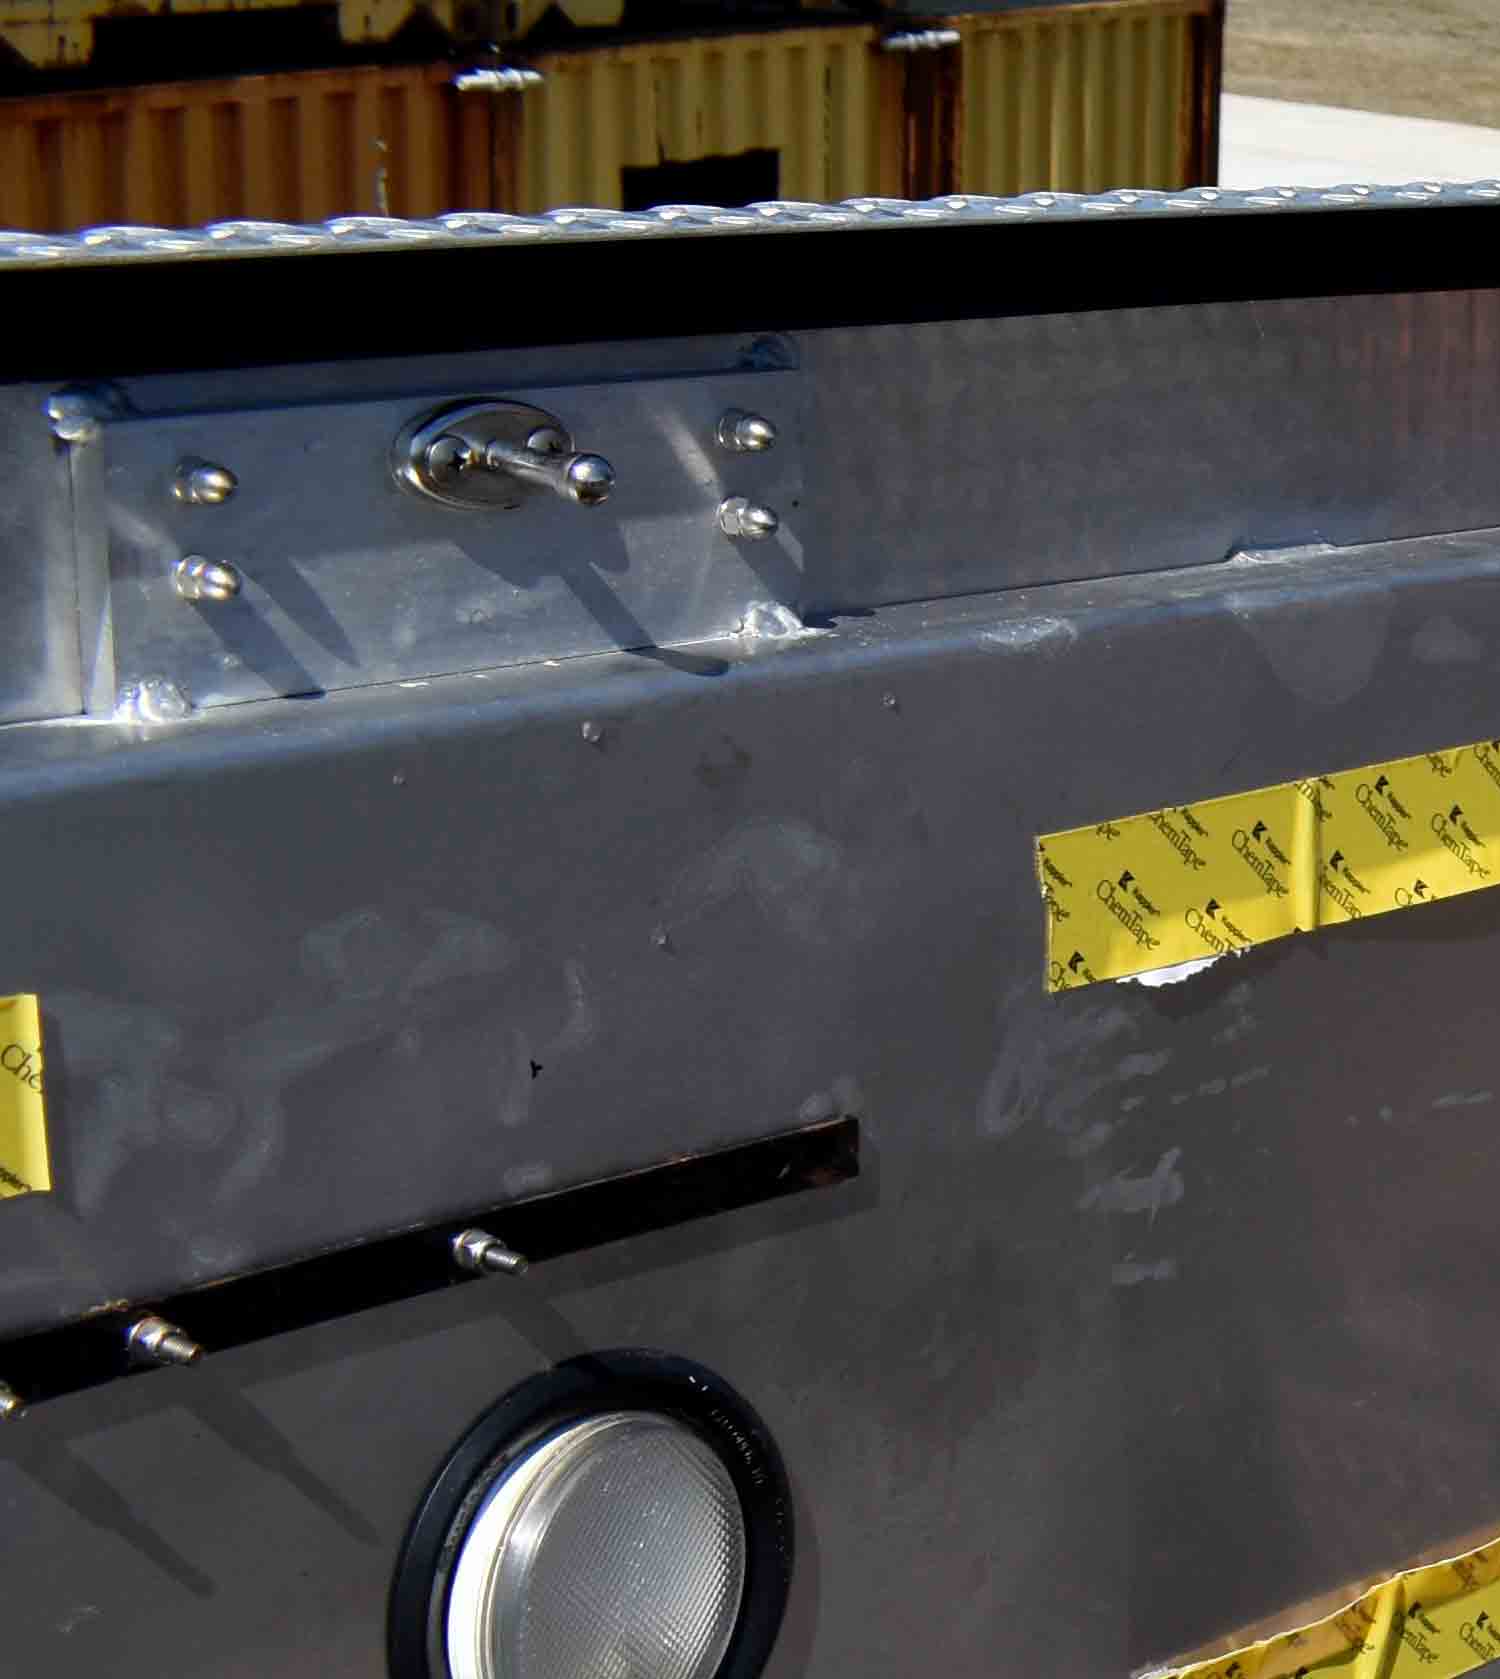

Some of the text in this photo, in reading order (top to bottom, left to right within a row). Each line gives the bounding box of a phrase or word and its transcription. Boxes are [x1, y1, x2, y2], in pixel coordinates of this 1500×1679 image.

[1355, 783, 1409, 851] ChemTape
[1431, 813, 1491, 878] ChemTape
[1231, 829, 1290, 898] ChemTape
[1096, 879, 1161, 951] ChemTape
[1184, 907, 1236, 953] ChemT
